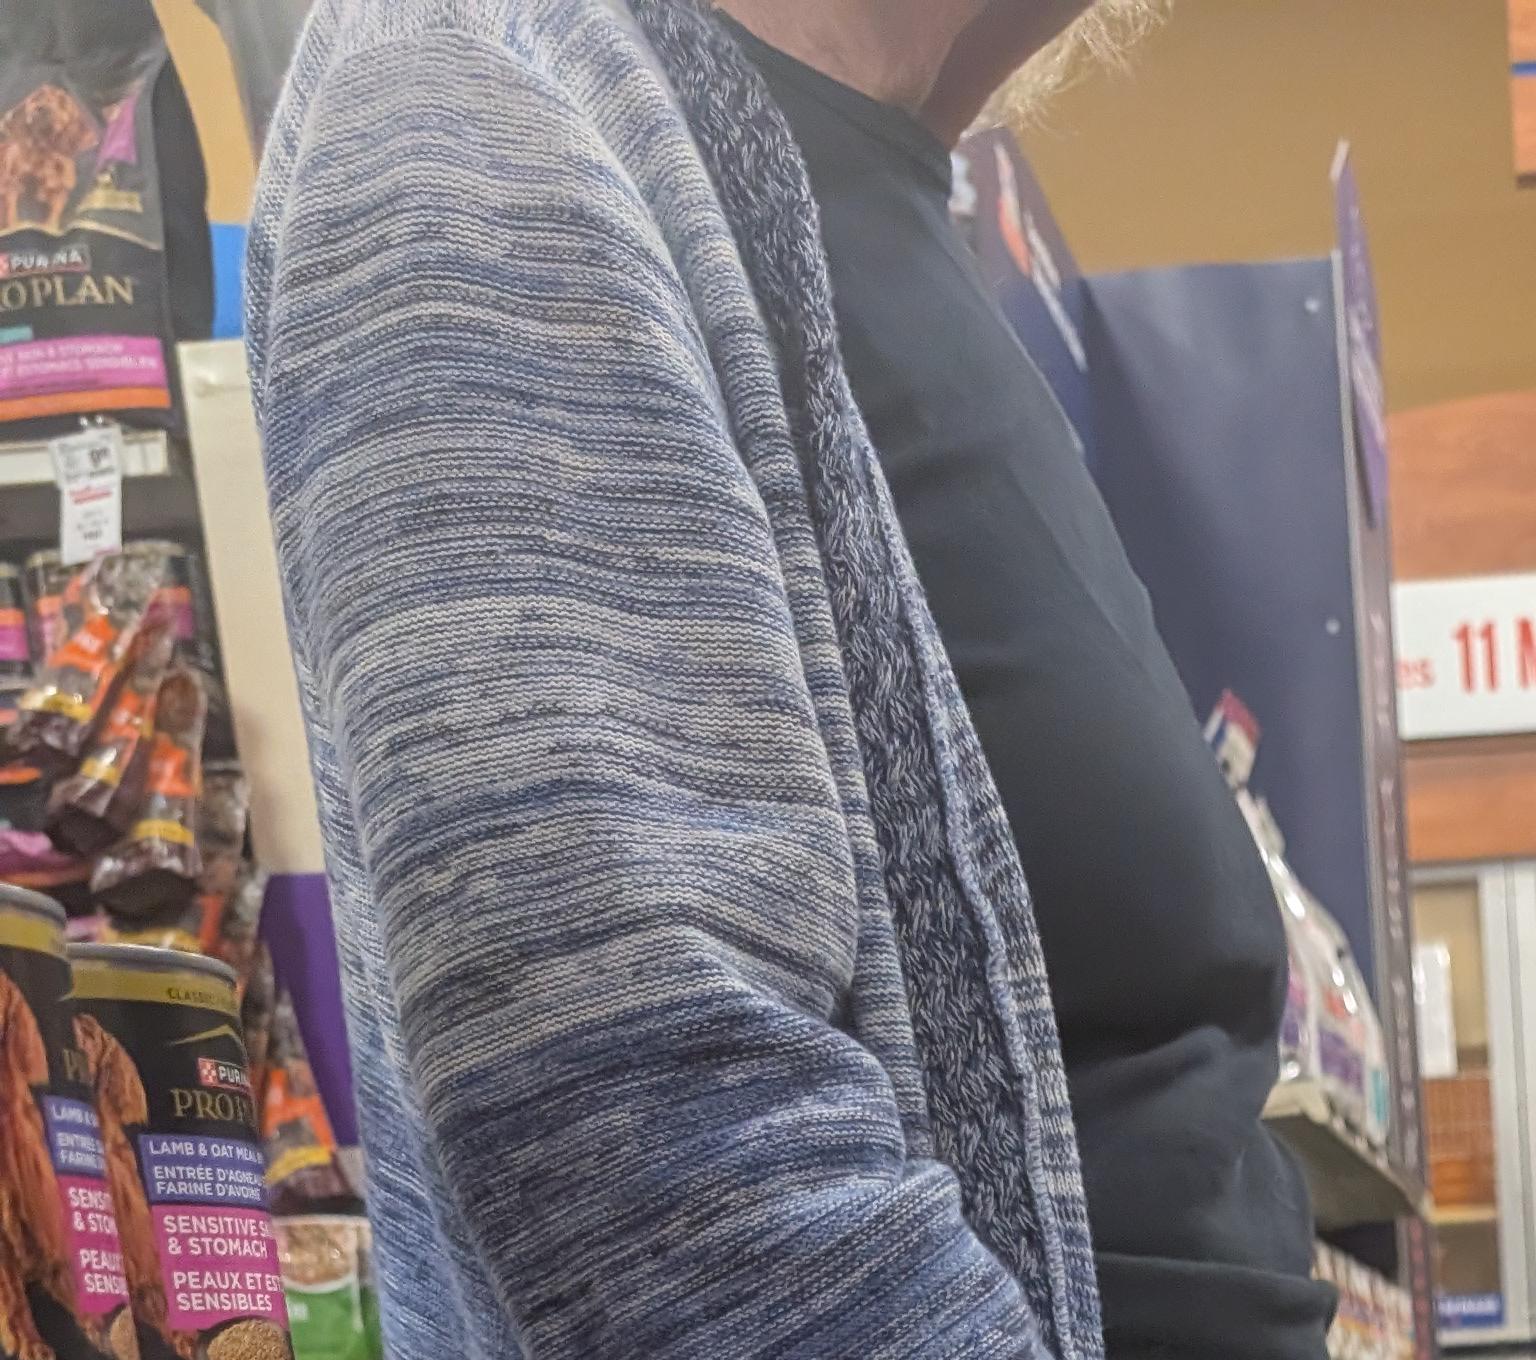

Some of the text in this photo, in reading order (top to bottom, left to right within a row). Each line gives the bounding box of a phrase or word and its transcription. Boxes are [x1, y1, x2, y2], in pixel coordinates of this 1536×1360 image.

[1452, 620, 1498, 694] 11
[150, 1140, 195, 1156] LAMB
[199, 1141, 208, 1156] &
[210, 1143, 234, 1158] OAT
[154, 1163, 214, 1182] ENTRÉE
[156, 1181, 213, 1196] FARINE
[163, 1214, 259, 1238] SENSITIVE
[168, 1237, 268, 1258] & STOMACH
[173, 1271, 243, 1292] PEAUX
[245, 1273, 263, 1291] ET
[176, 1292, 273, 1312] SENSIBLES
